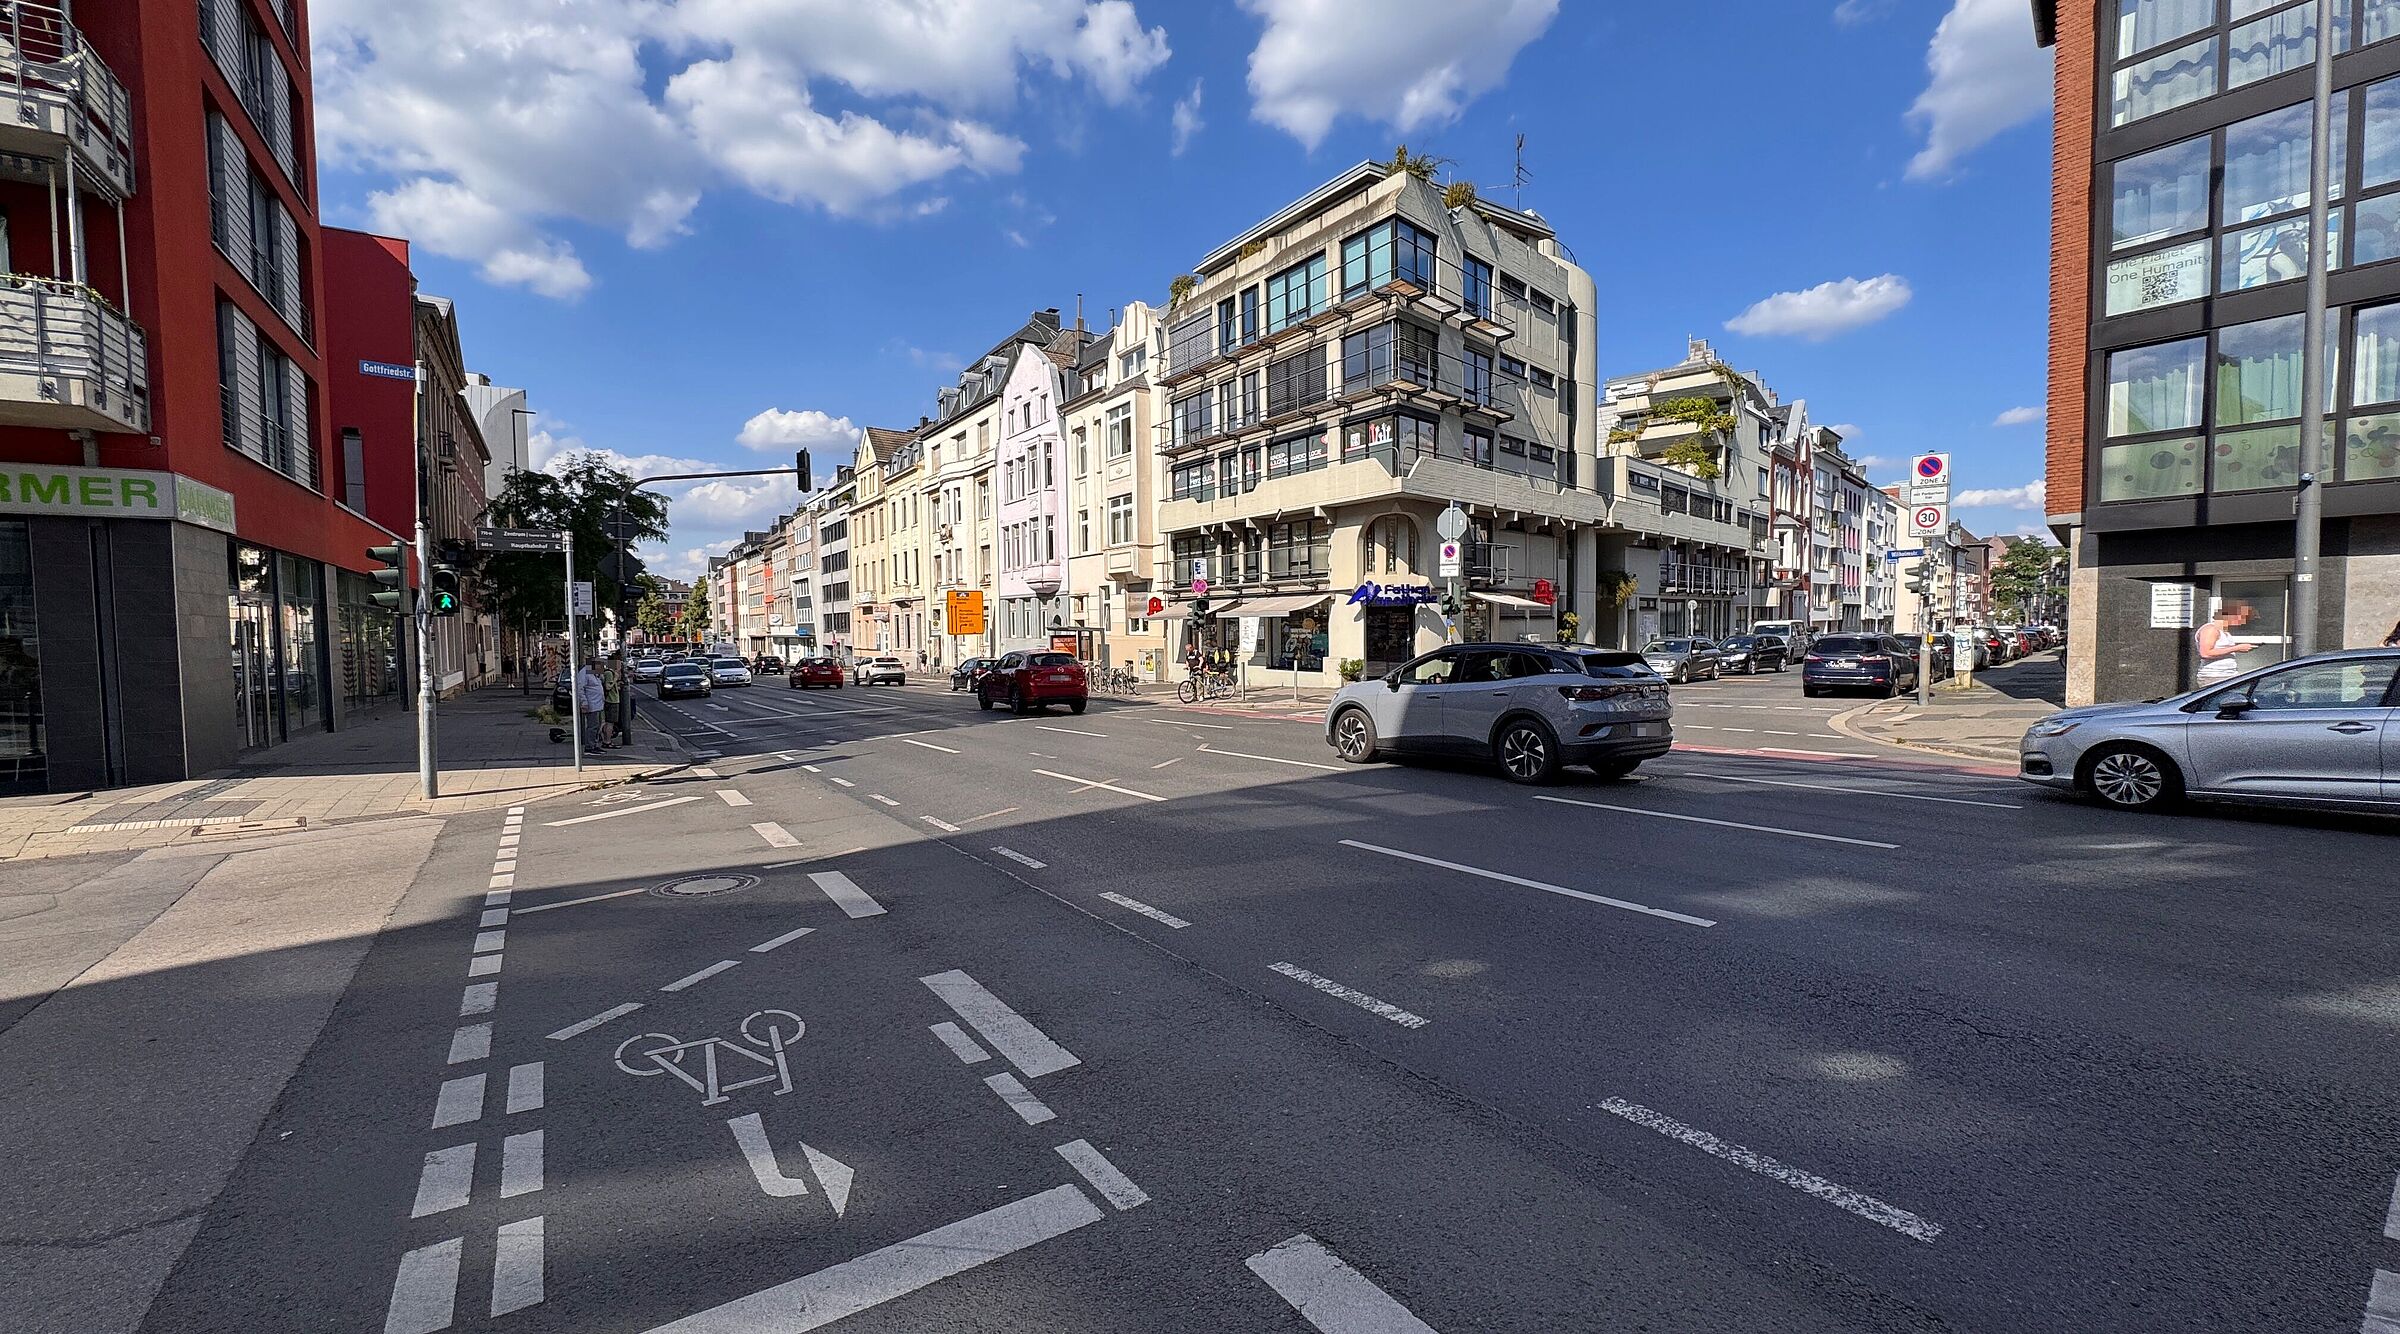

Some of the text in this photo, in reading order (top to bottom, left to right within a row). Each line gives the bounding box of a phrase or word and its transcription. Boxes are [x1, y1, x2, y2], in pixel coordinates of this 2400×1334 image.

[2109, 249, 2185, 271] One Planet
[2109, 255, 2211, 284] One Humanity
[1920, 512, 1936, 523] 30
